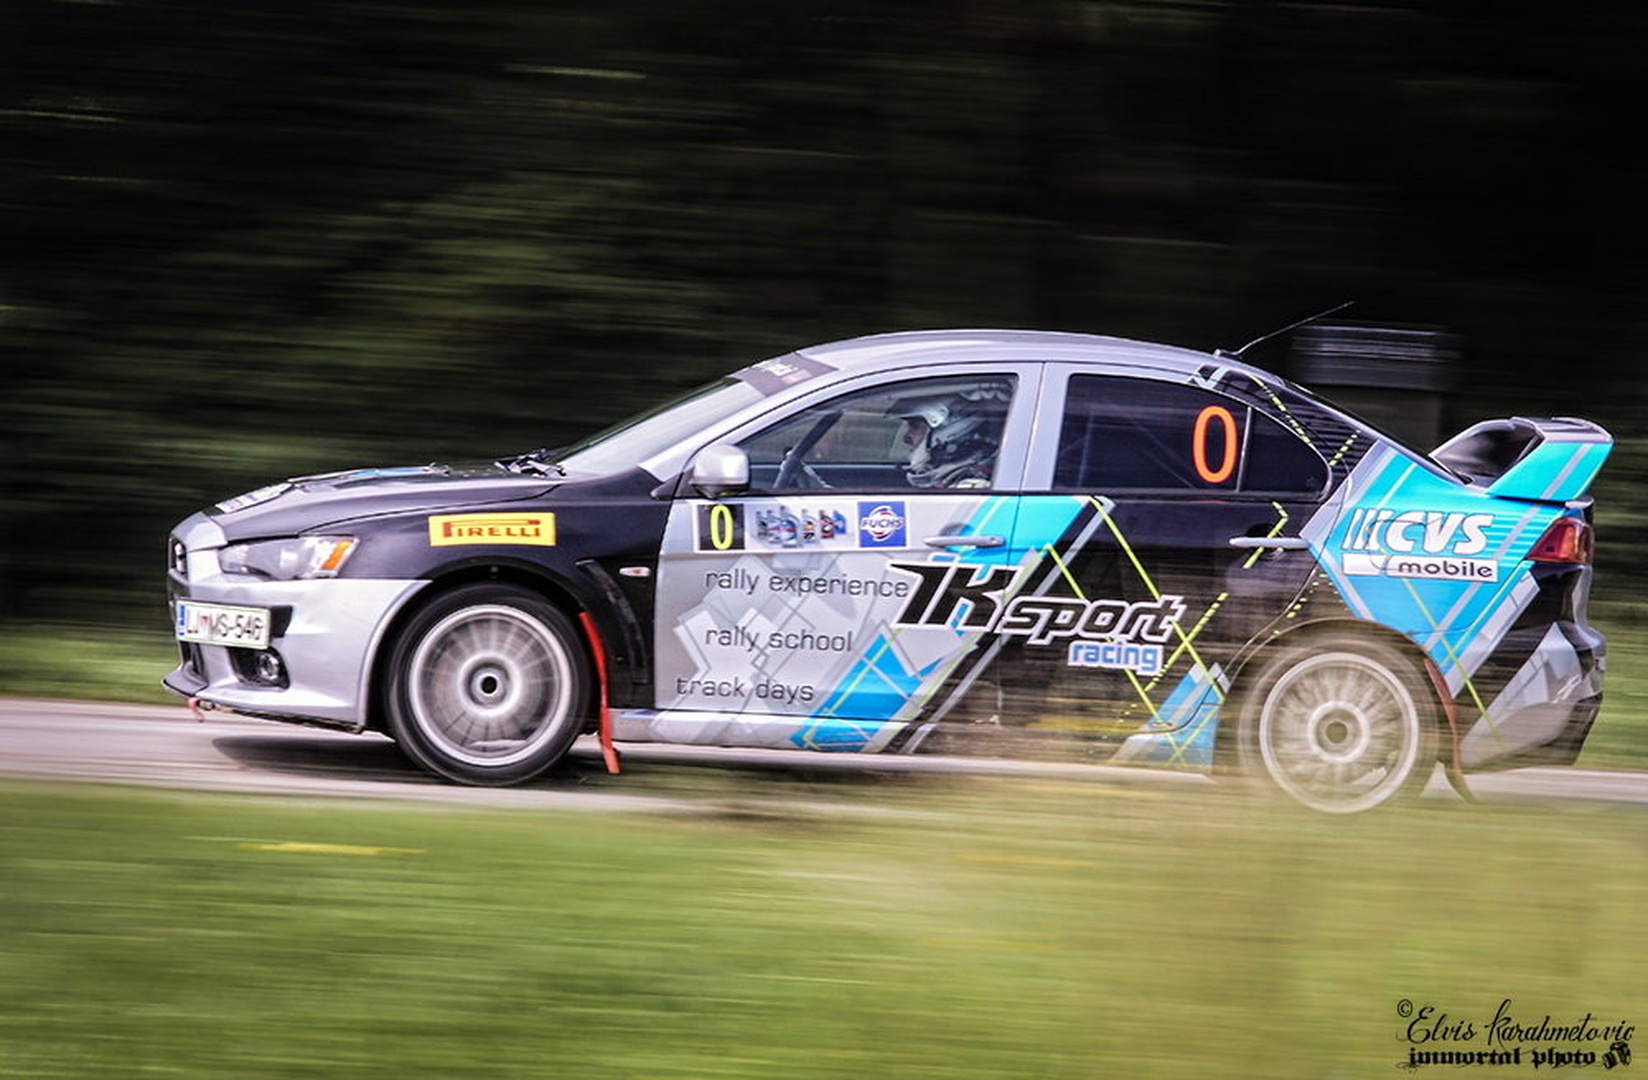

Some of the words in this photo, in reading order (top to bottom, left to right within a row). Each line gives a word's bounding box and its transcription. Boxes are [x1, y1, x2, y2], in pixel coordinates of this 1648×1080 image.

[1193, 405, 1237, 484] 0
[442, 519, 541, 538] PIRELLI
[710, 504, 733, 550] 0
[861, 519, 904, 528] FUCHS
[1386, 511, 1494, 555] CVS
[705, 568, 759, 595] rally
[769, 574, 909, 597] experience
[1399, 561, 1493, 578] mobile
[705, 626, 759, 652] rally
[769, 631, 853, 652] school
[1073, 642, 1158, 671] racing
[677, 677, 745, 697] track
[755, 680, 814, 704] days
